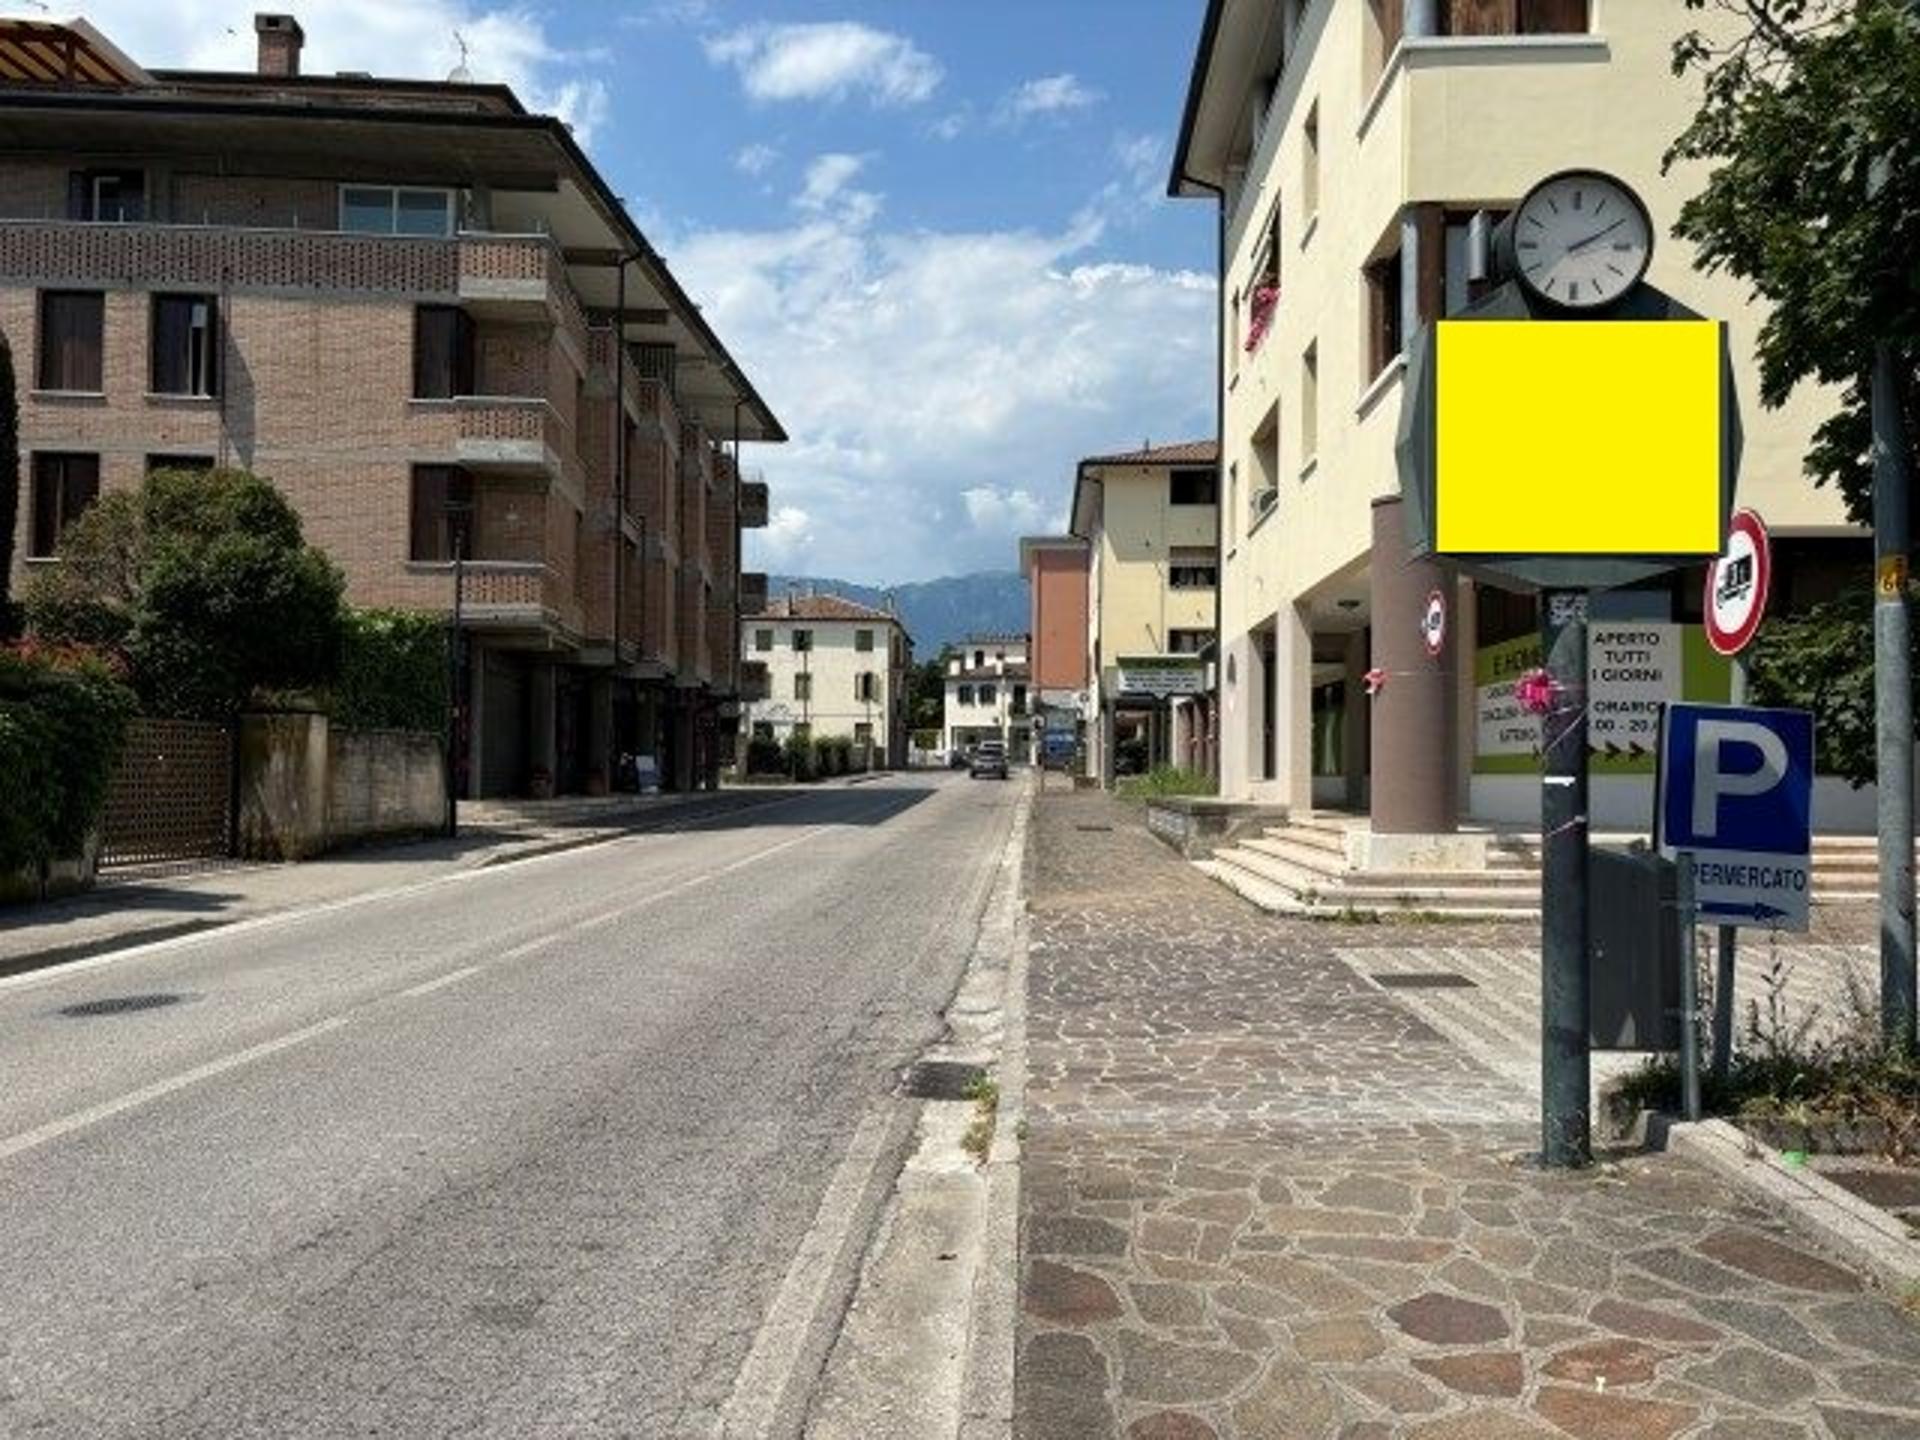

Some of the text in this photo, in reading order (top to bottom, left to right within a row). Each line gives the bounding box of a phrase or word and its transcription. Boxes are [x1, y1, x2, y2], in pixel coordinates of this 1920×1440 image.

[1594, 632, 1660, 645] APERTO
[1605, 651, 1650, 663] TUTTI
[1592, 668, 1663, 681] I GIORNI
[1594, 701, 1659, 713] ORARIO
[1692, 719, 1788, 837] P
